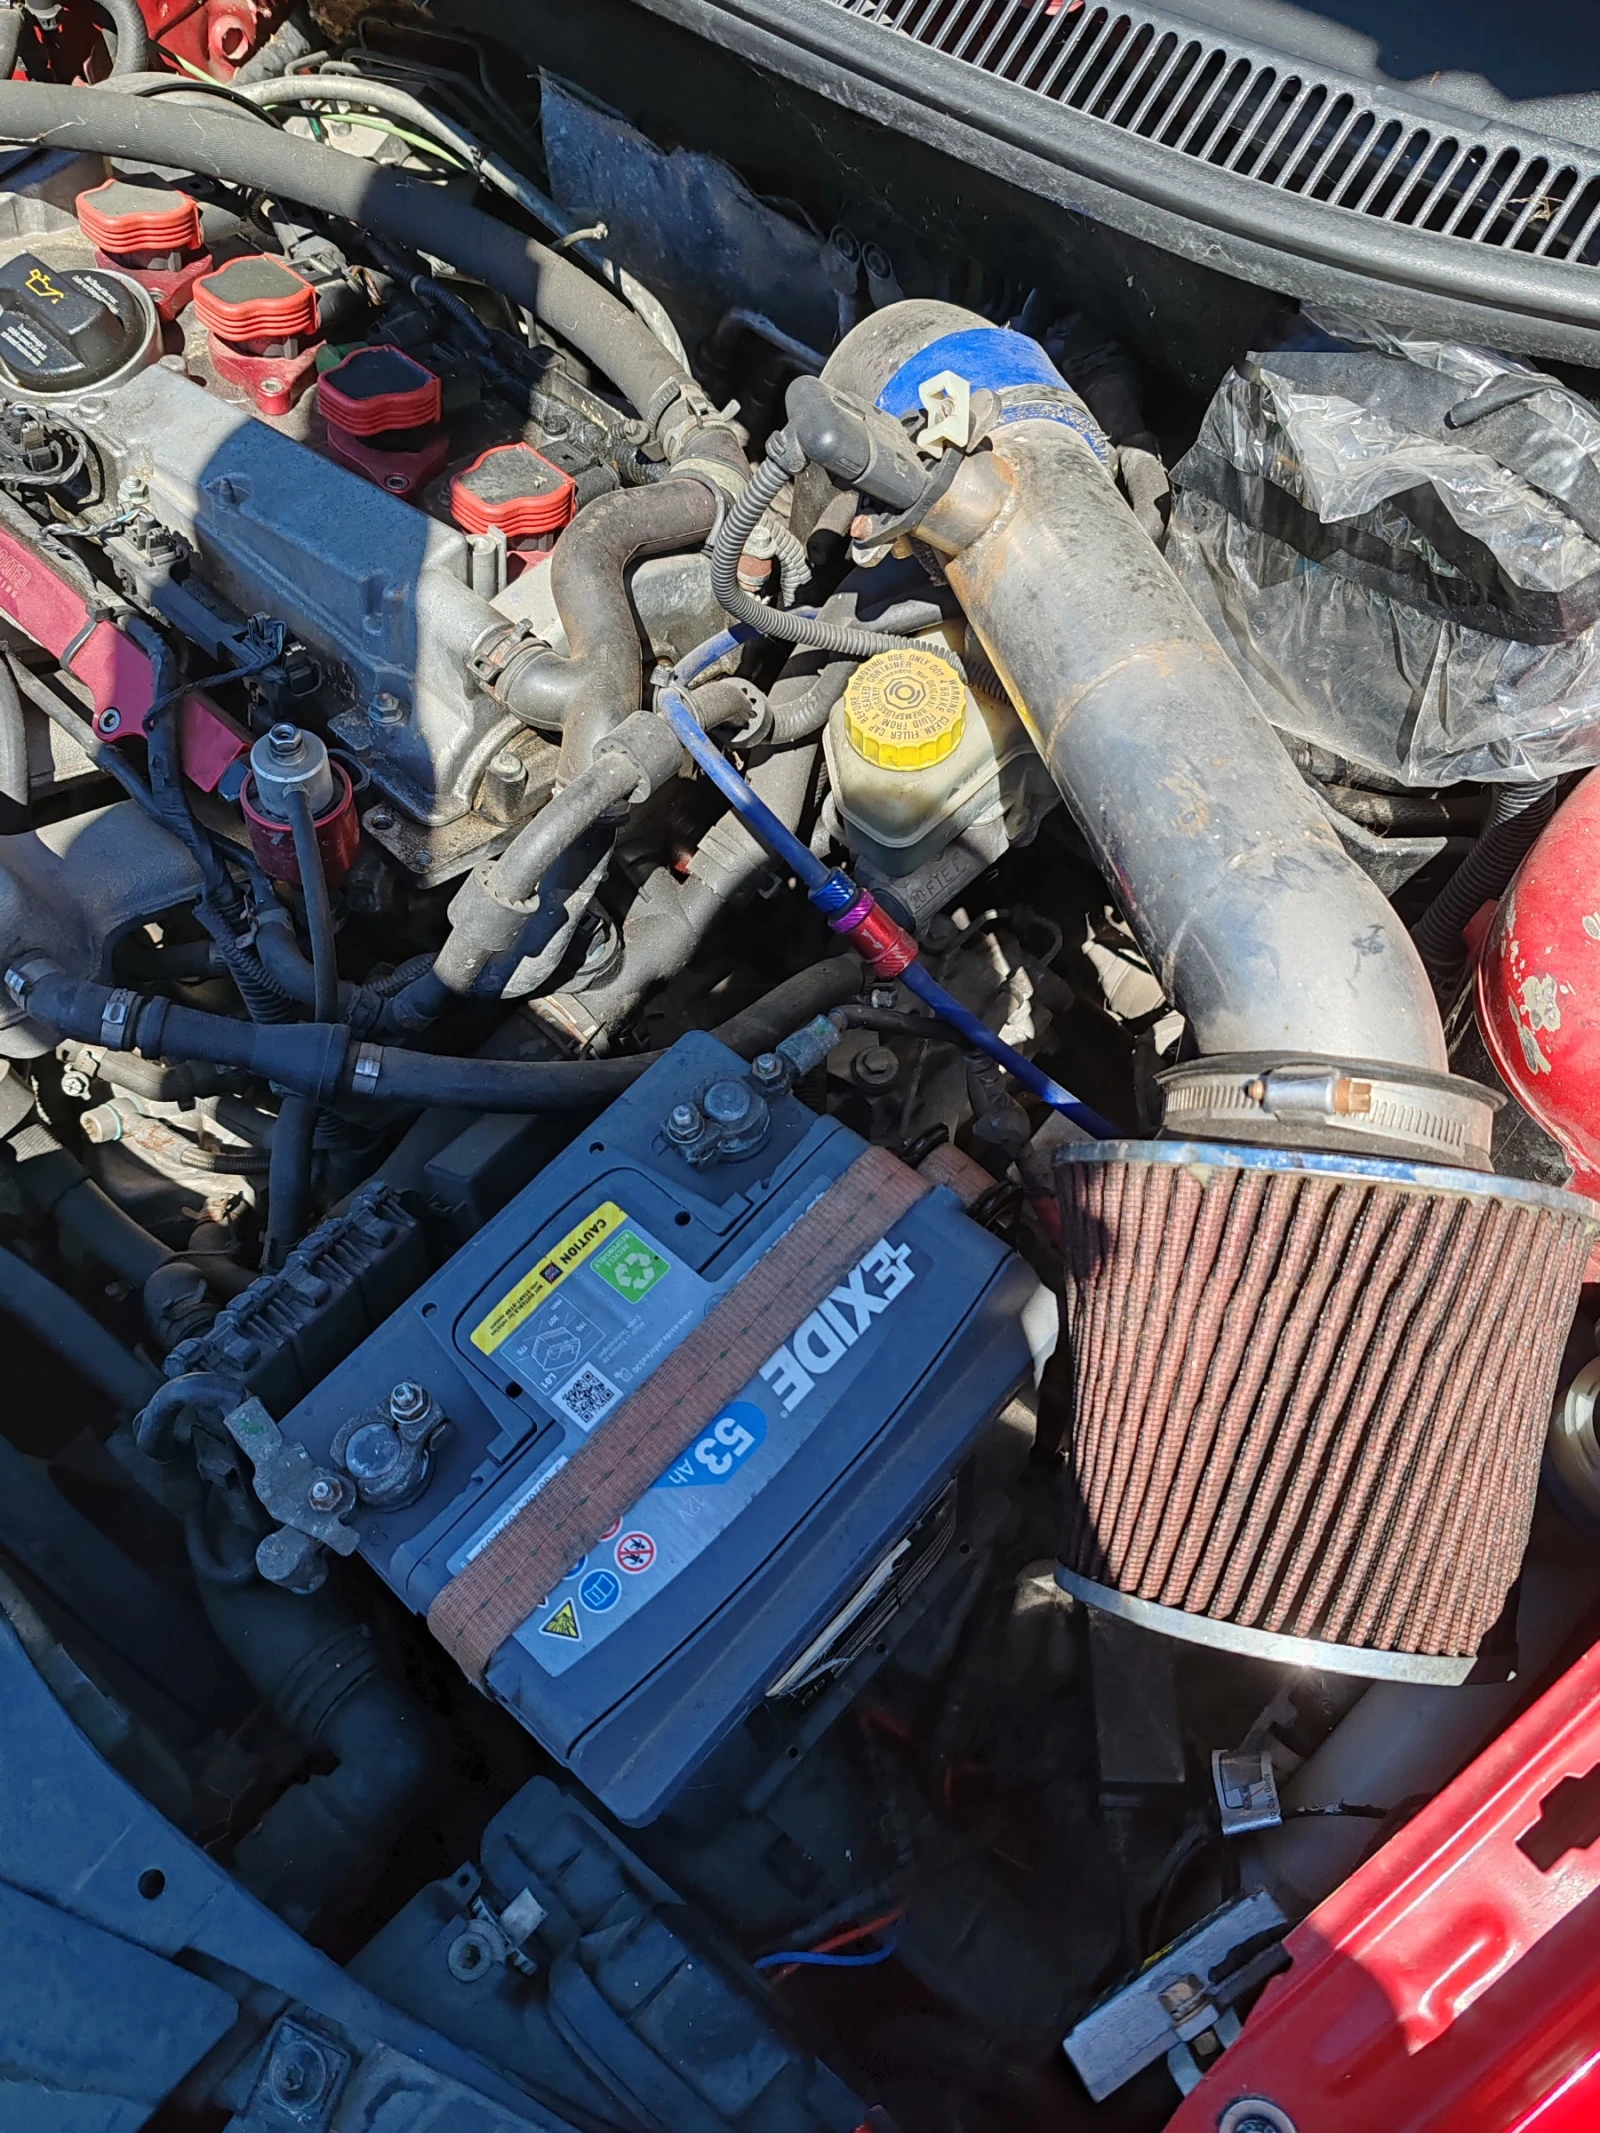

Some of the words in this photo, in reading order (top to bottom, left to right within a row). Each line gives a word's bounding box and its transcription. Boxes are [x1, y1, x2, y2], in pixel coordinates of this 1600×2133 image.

[909, 654, 932, 666] ONLY
[851, 658, 884, 690] REMOVING
[866, 660, 912, 683] CONTAINER
[929, 664, 945, 677] DOT
[861, 686, 874, 712] SEALED
[926, 680, 938, 710] ORIGINAL
[935, 686, 950, 713] BRAKE
[948, 678, 960, 715] WARNING
[850, 696, 869, 724] BEFORE
[868, 724, 886, 737] CAP
[881, 718, 908, 730] FROM
[912, 713, 937, 729] FLUID
[924, 716, 950, 736] CLEAN
[890, 730, 920, 740] FILLER
[560, 1218, 607, 1264] CAUTION
[595, 1233, 630, 1269] RESPONSIBLY
[604, 1244, 630, 1268] RECYCLE
[505, 1289, 531, 1315] START-STOP
[514, 1293, 536, 1314] SUITABLE
[550, 1298, 562, 1310] mm
[490, 1314, 506, 1330] system
[491, 1319, 508, 1336] vehicles
[548, 1314, 559, 1327] 207
[576, 1322, 587, 1332] 190
[627, 1314, 642, 1329] Exide
[631, 1321, 646, 1335] Made
[758, 1237, 916, 1412] EXIDE
[597, 1329, 628, 1358] Technologies
[610, 1339, 628, 1356] Europe
[541, 1372, 557, 1389] L01
[694, 1418, 756, 1475] 53
[668, 1458, 695, 1484] Ah
[676, 1495, 706, 1524] 12V
[1264, 1774, 1272, 1793] Body
[1267, 1794, 1276, 1809] Car
[1269, 1811, 1277, 1820] to
